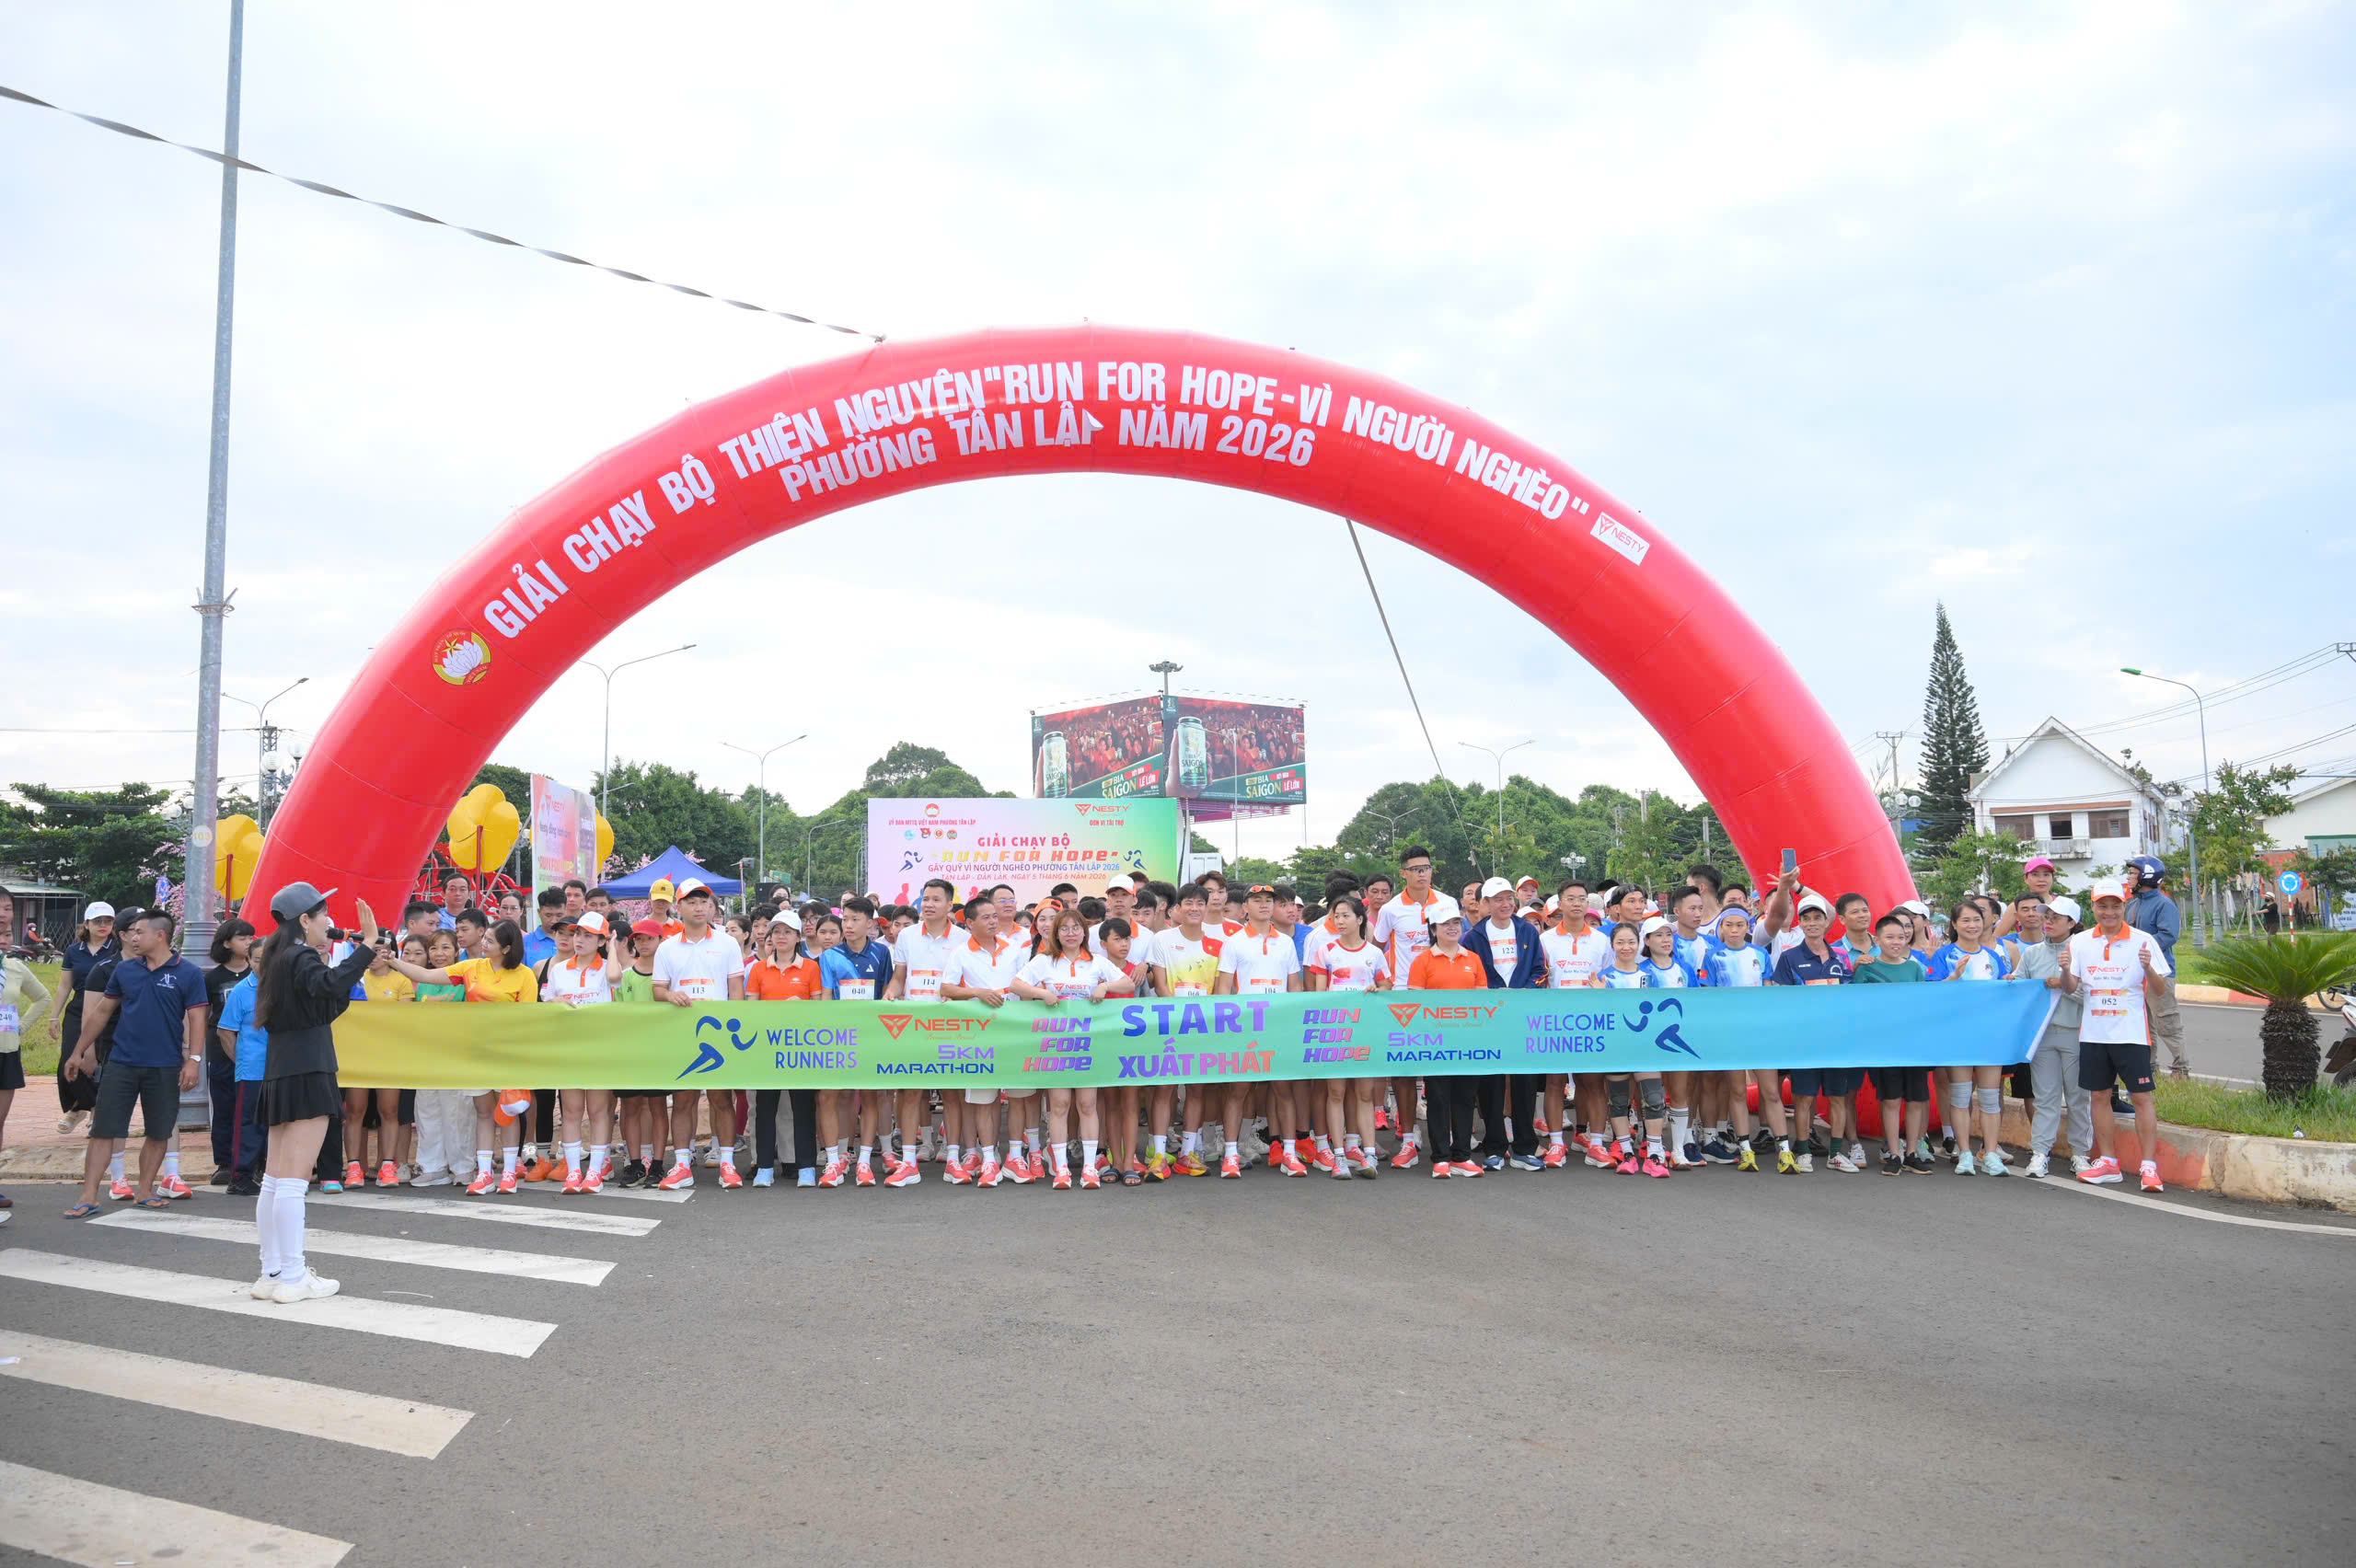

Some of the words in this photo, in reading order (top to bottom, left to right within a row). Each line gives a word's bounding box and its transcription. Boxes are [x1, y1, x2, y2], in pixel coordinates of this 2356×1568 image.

[779, 427, 937, 502] PHƯỜNG
[949, 409, 1023, 455] TÂN
[1118, 403, 1208, 451] NĂM
[1216, 415, 1315, 467] 2026
[484, 559, 569, 638] GIẢI
[562, 490, 656, 572] CHẠY
[657, 454, 716, 514] BỘ
[718, 407, 829, 478] THIỆN
[1099, 362, 1166, 401] FOR
[1342, 396, 1454, 466] NGƯỜI
[1611, 527, 1645, 552] NESTY
[1114, 774, 1124, 784] BIA
[1257, 775, 1268, 784] BIA
[1102, 778, 1137, 799] SAIGON
[1245, 781, 1282, 799] SAIGON
[977, 833, 1006, 847] GIẢI
[1011, 836, 1046, 849] CHẠY
[1052, 832, 1070, 849] BỘ
[999, 850, 1041, 861] FOR
[964, 863, 972, 871] VÌ
[974, 863, 1000, 871] NGƯỜI
[1003, 863, 1031, 871] NGHÈO
[1033, 863, 1068, 871] PHƯỜNG
[1069, 862, 1085, 871] TÂN
[2101, 997, 2118, 1006] 052
[1121, 1000, 1270, 1037] START
[1302, 1008, 1362, 1024] RUN
[1423, 1006, 1498, 1019] NESTY
[915, 1018, 990, 1031] NESTY
[1031, 1017, 1092, 1032] RUN
[1526, 1013, 1616, 1031] WELCOME
[766, 1028, 859, 1045] WELCOME
[1302, 1027, 1354, 1043] FOR
[1388, 1032, 1443, 1046] 5KM
[938, 1043, 995, 1059] 5KM
[1039, 1036, 1091, 1052] FOR
[1526, 1035, 1606, 1053] RUNNERS
[775, 1051, 858, 1068] RUNNERS
[1118, 1037, 1195, 1078] XUẤT
[1199, 1040, 1275, 1075] PHÁT
[1302, 1045, 1370, 1063] HOPE
[1386, 1049, 1501, 1062] MARATHON
[876, 1063, 995, 1074] MARATHON
[1022, 1055, 1092, 1072] HOPE
